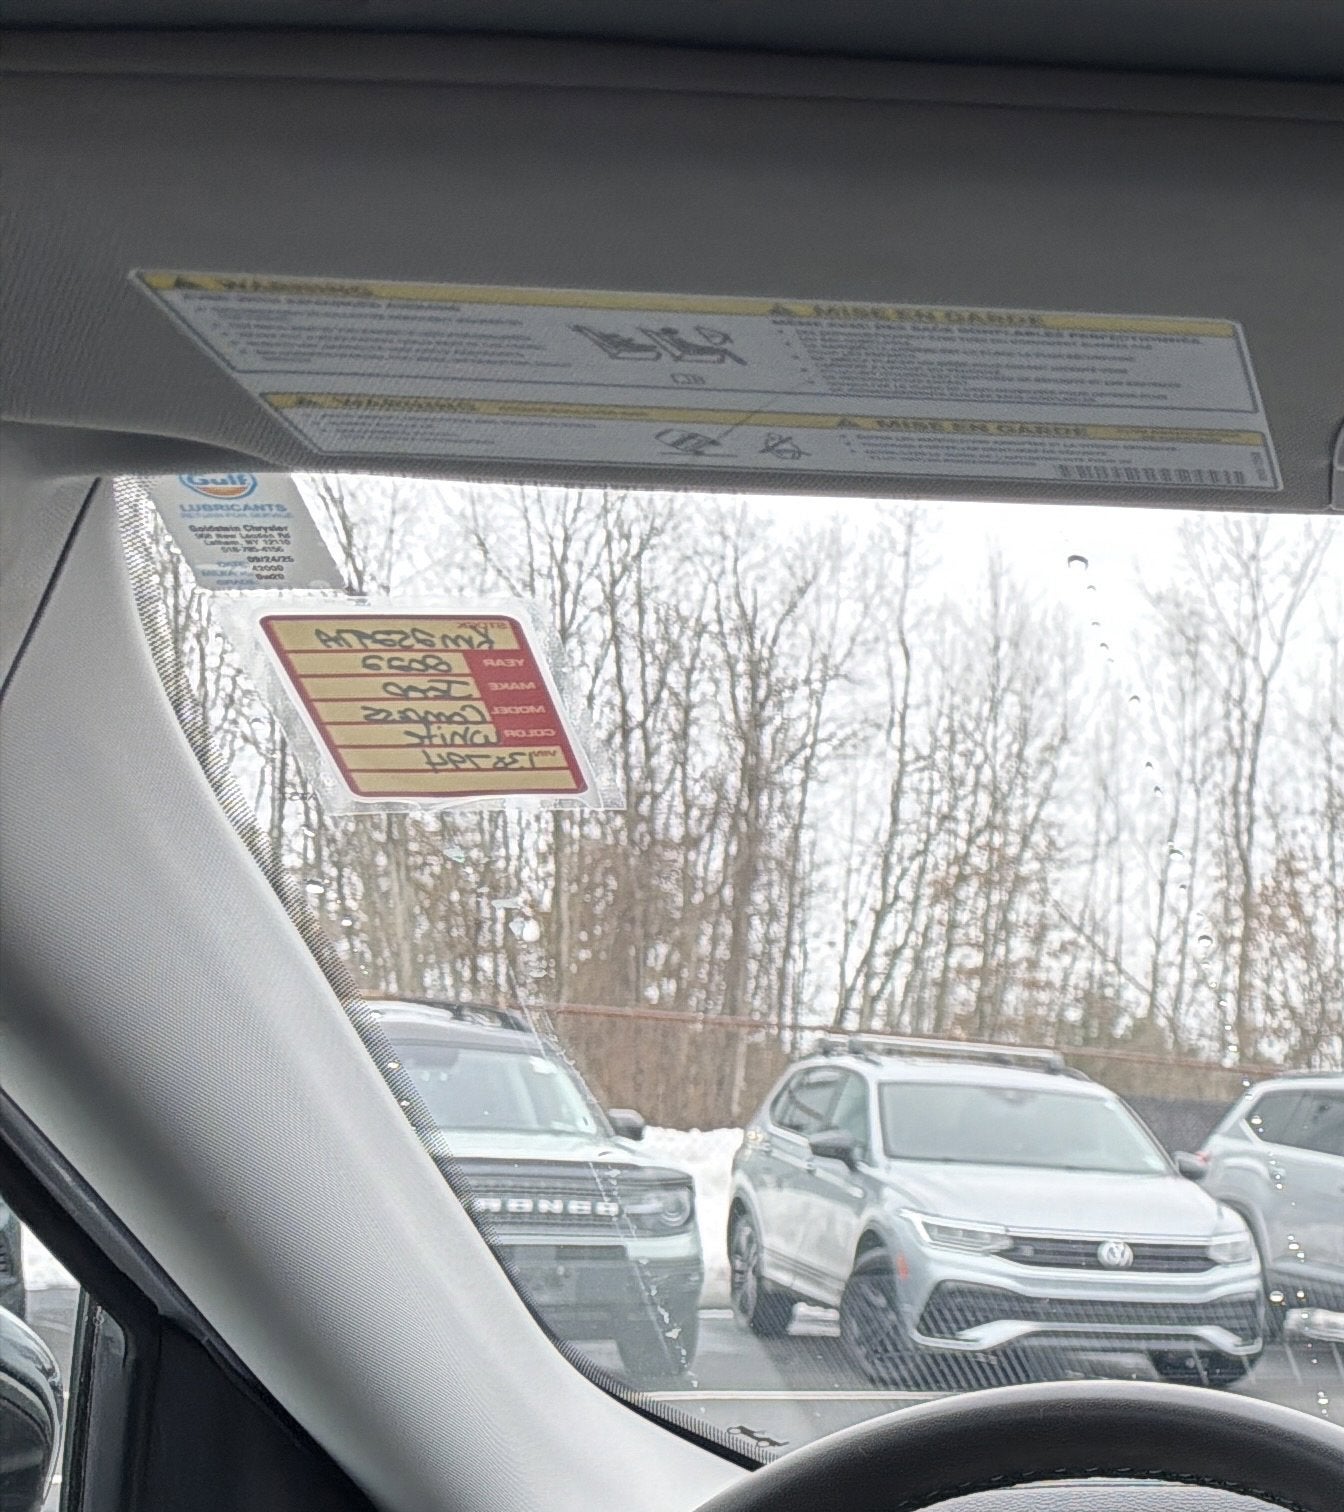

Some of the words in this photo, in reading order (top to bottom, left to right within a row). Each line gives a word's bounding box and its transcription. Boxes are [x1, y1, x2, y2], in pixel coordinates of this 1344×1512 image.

[180, 503, 288, 512] LUBRICANTS
[242, 524, 288, 533] Chrysler
[477, 1197, 620, 1217] RONCO
